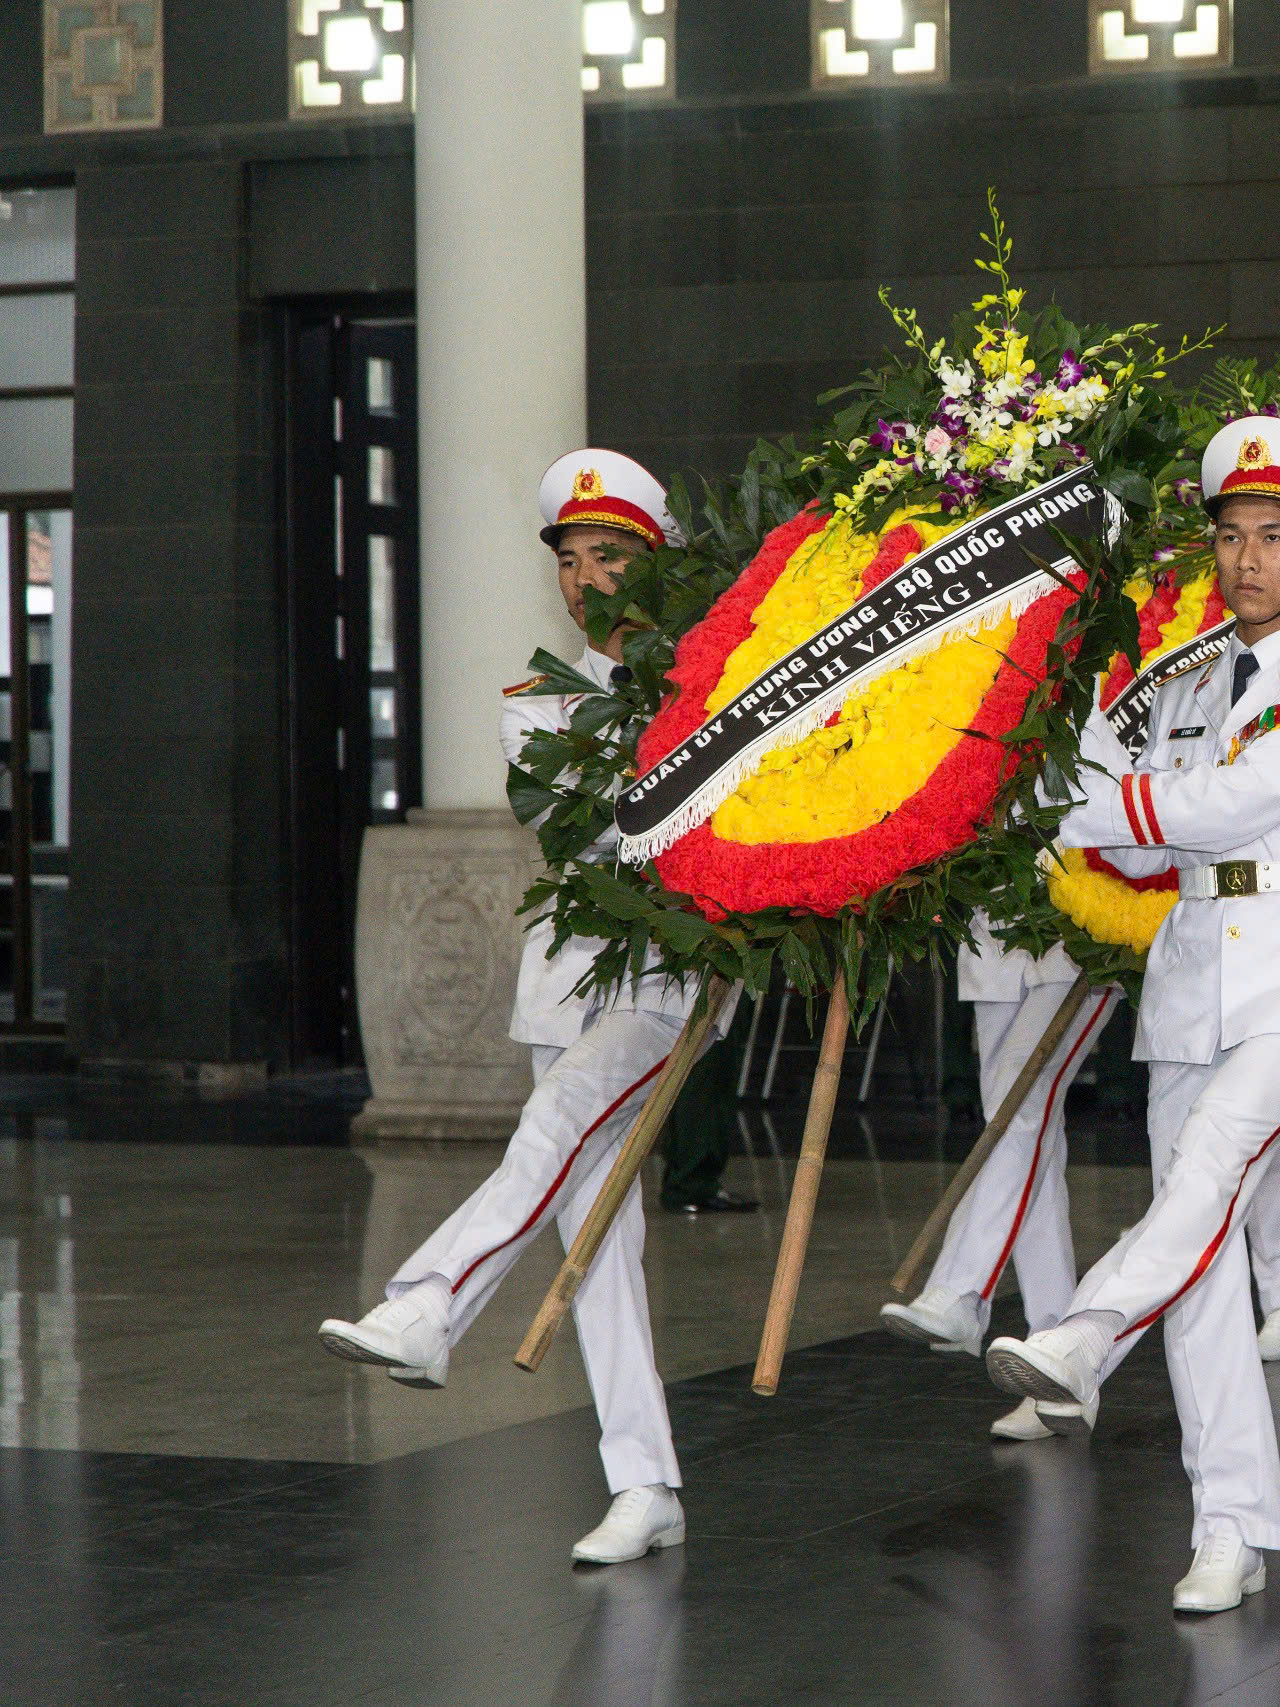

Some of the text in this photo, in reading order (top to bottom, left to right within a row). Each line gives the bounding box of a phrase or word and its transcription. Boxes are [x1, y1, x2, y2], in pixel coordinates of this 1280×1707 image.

[628, 749, 692, 803] QUÂN
[694, 719, 724, 748] ỦY
[728, 657, 808, 719] TRUNG
[808, 605, 879, 658] ƯƠNG
[895, 567, 933, 599] BỘ
[935, 528, 1005, 574] QUỐC
[1005, 483, 1096, 537] PHÒNG
[754, 571, 993, 728] KÍNH VIẾNG !
[1109, 706, 1131, 734] HÍ
